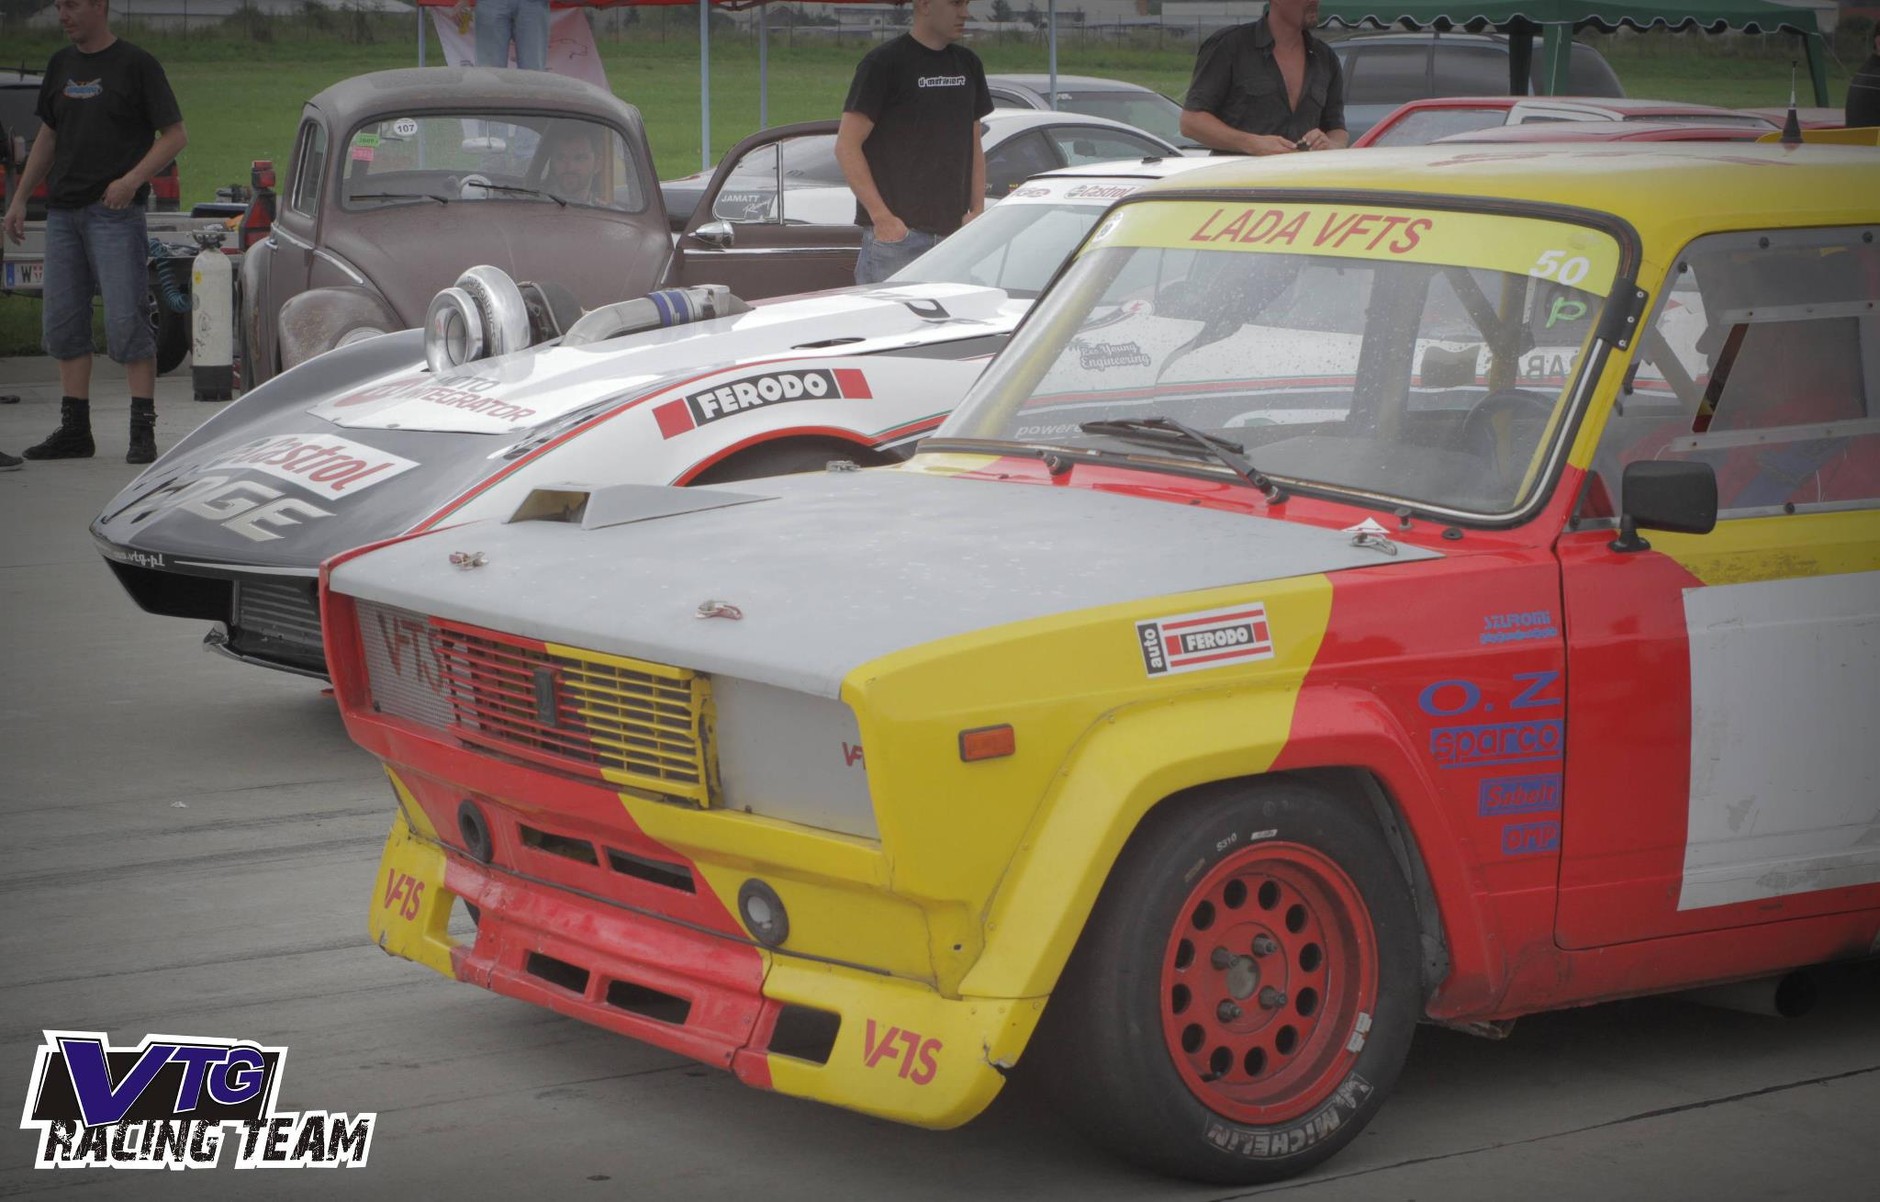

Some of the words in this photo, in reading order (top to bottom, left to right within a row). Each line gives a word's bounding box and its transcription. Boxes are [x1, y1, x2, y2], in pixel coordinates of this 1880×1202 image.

[397, 124, 414, 133] 107
[721, 194, 760, 203] JAMATT
[1189, 208, 1311, 246] LADA
[1312, 211, 1433, 255] VFTS
[1529, 250, 1590, 287] 50
[696, 372, 829, 420] FERODO
[1144, 628, 1163, 669] auto
[1186, 627, 1249, 651] FERODO
[1434, 723, 1560, 766] sparco
[1487, 782, 1555, 808] Sabelt
[1507, 827, 1557, 850] OMP
[864, 1018, 944, 1086] VFTS
[1207, 1107, 1341, 1157] MICHELIN
